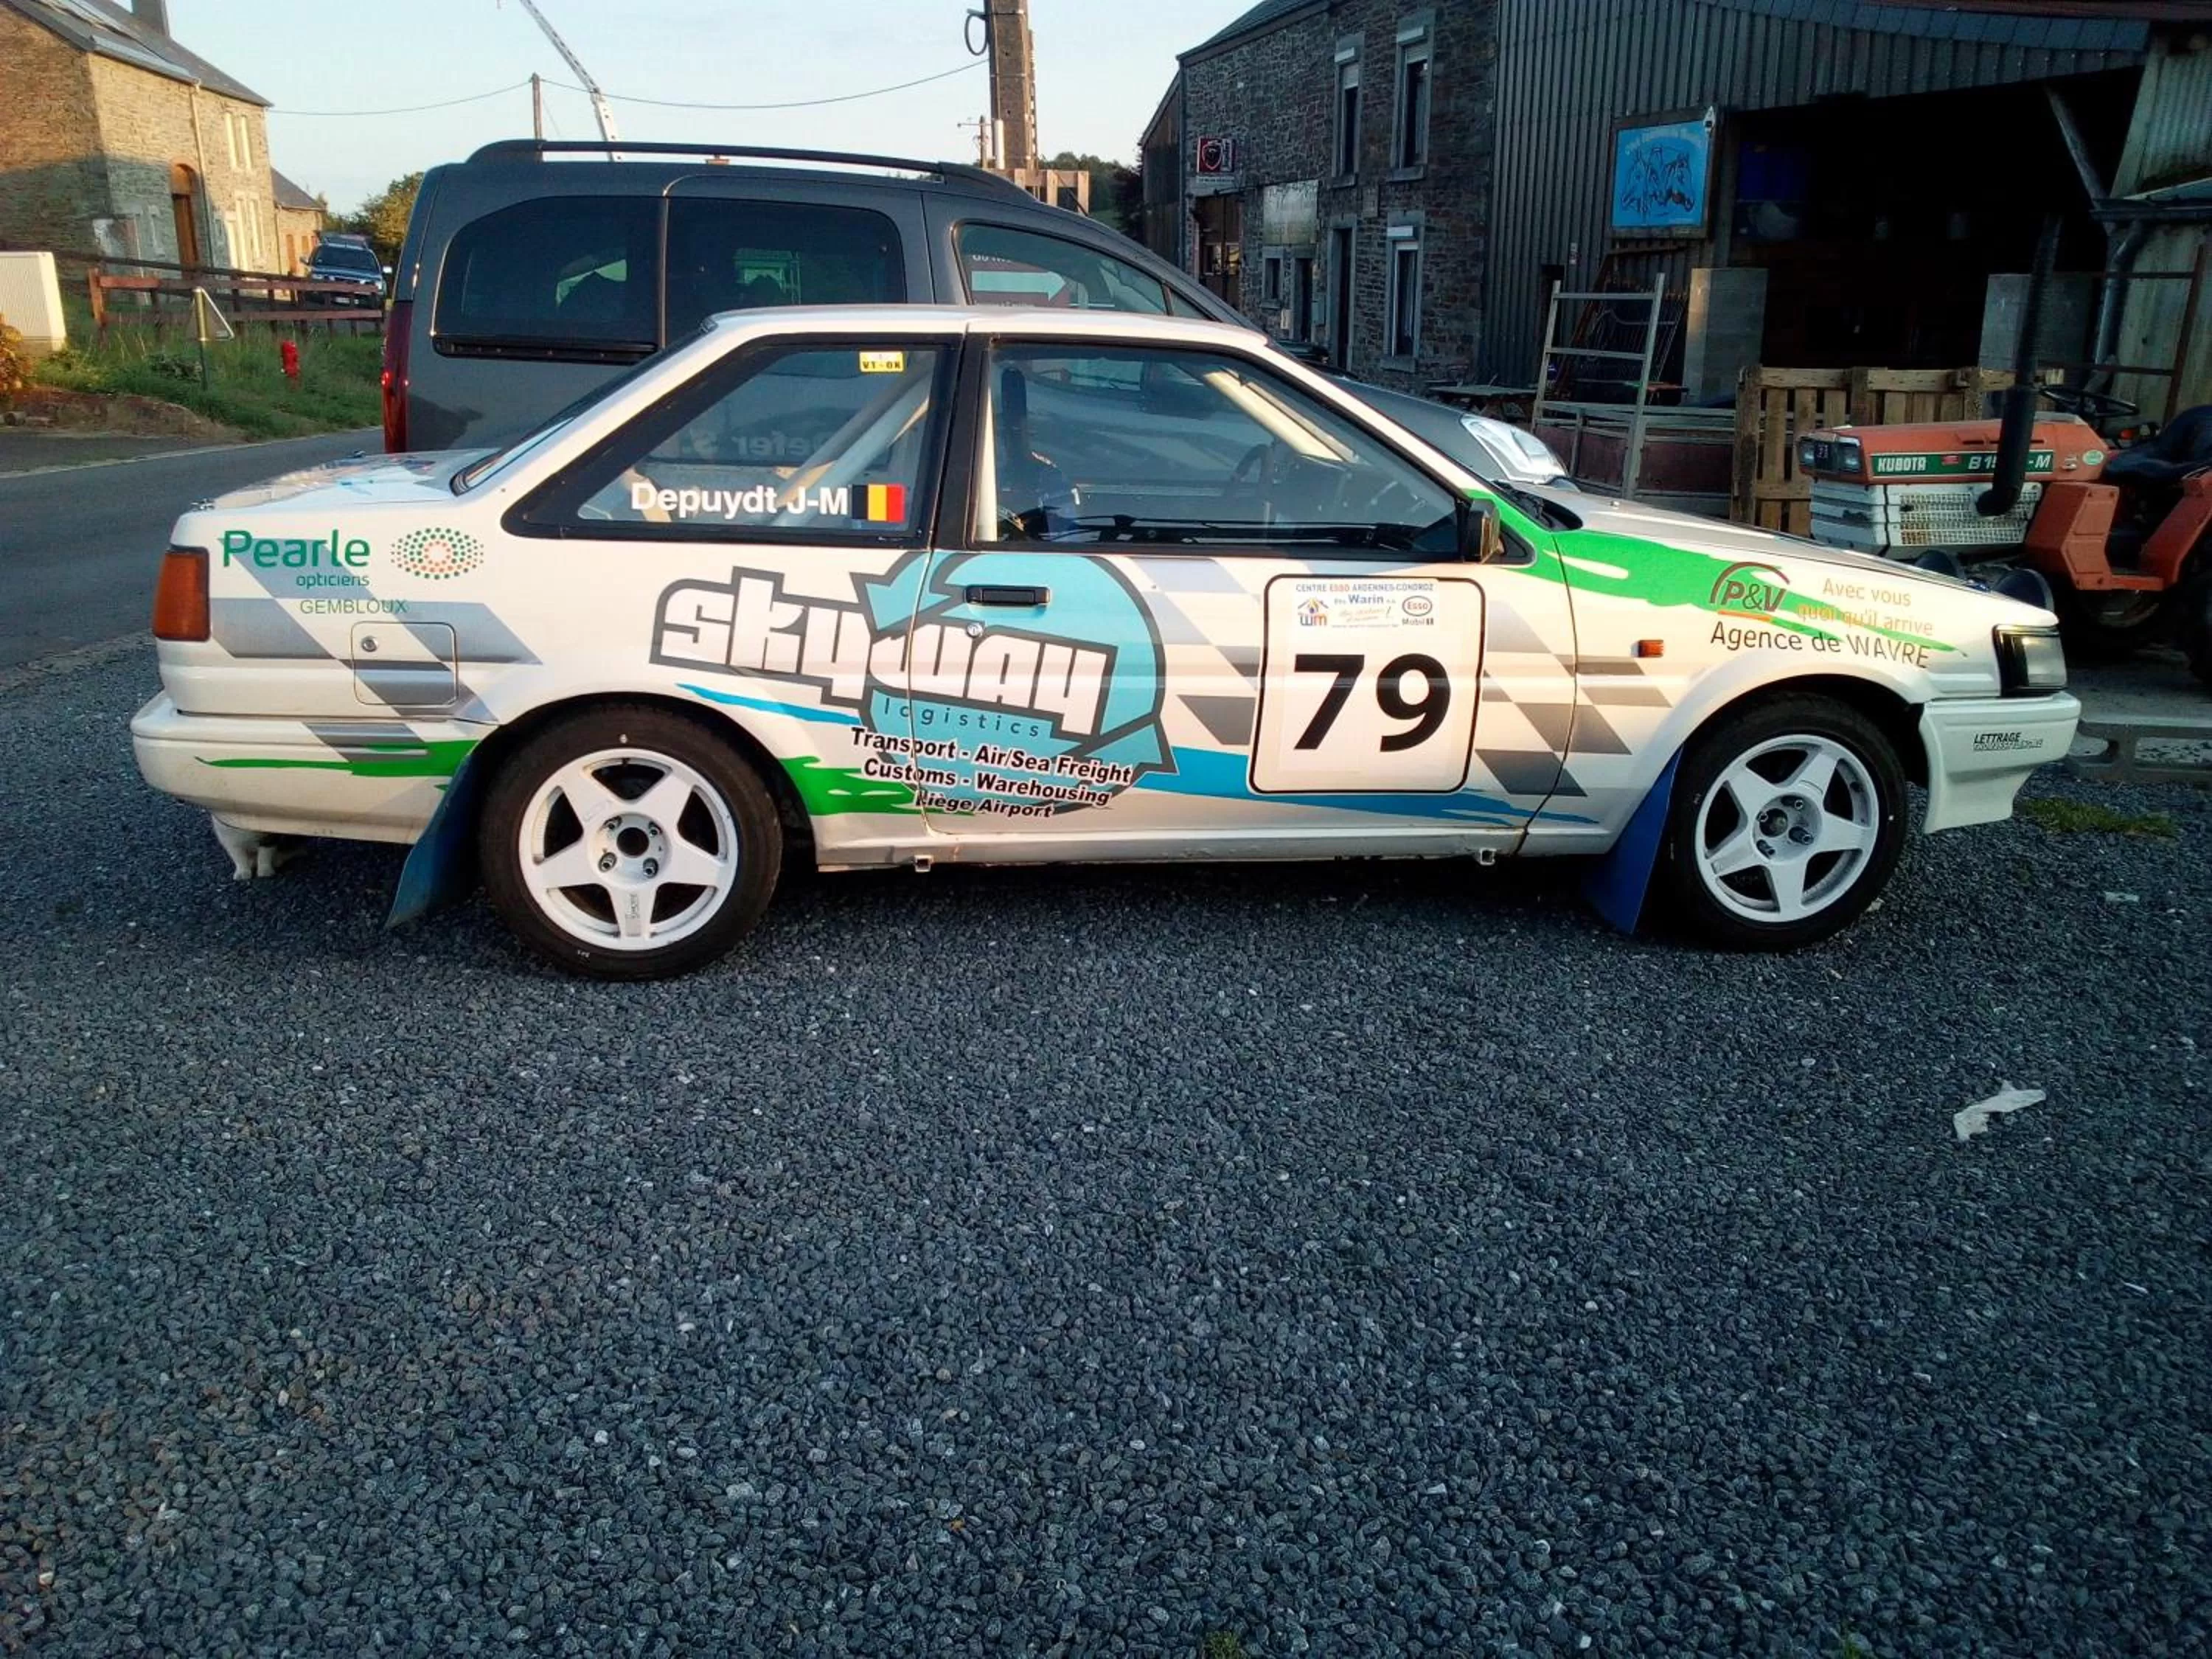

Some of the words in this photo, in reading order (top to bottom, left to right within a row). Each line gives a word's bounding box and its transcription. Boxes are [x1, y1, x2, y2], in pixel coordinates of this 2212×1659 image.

[1877, 456, 1927, 473] KUBOTA
[631, 481, 778, 520] Depuydt
[787, 486, 849, 515] J-M
[223, 529, 372, 568] Pearle
[295, 571, 370, 590] opticiens
[1295, 583, 1327, 593] CENTRE
[1329, 583, 1350, 592] ESSO
[1719, 578, 1787, 613] P&V
[1822, 577, 1866, 600] Avec
[1871, 587, 1912, 607] vous
[299, 598, 408, 615] GEMBLOUX
[1348, 594, 1385, 605] Warin
[1796, 603, 1836, 622] quoi
[1843, 607, 1877, 629] qu'il
[1883, 614, 1935, 636] arrive
[653, 569, 1114, 738] skyway
[1710, 621, 1803, 651] Agence
[1811, 632, 1841, 653] de
[1846, 633, 1933, 669] WAVRE
[884, 697, 1040, 737] logistics
[1293, 653, 1452, 753] 79
[1974, 731, 2023, 744] LETTRAGE
[851, 726, 957, 759] Transport
[974, 745, 1050, 773] Air/Sea
[1056, 757, 1132, 785] Freight
[863, 758, 956, 787] Customs
[976, 772, 1111, 807] Warehousing
[978, 798, 1055, 819] Airport
